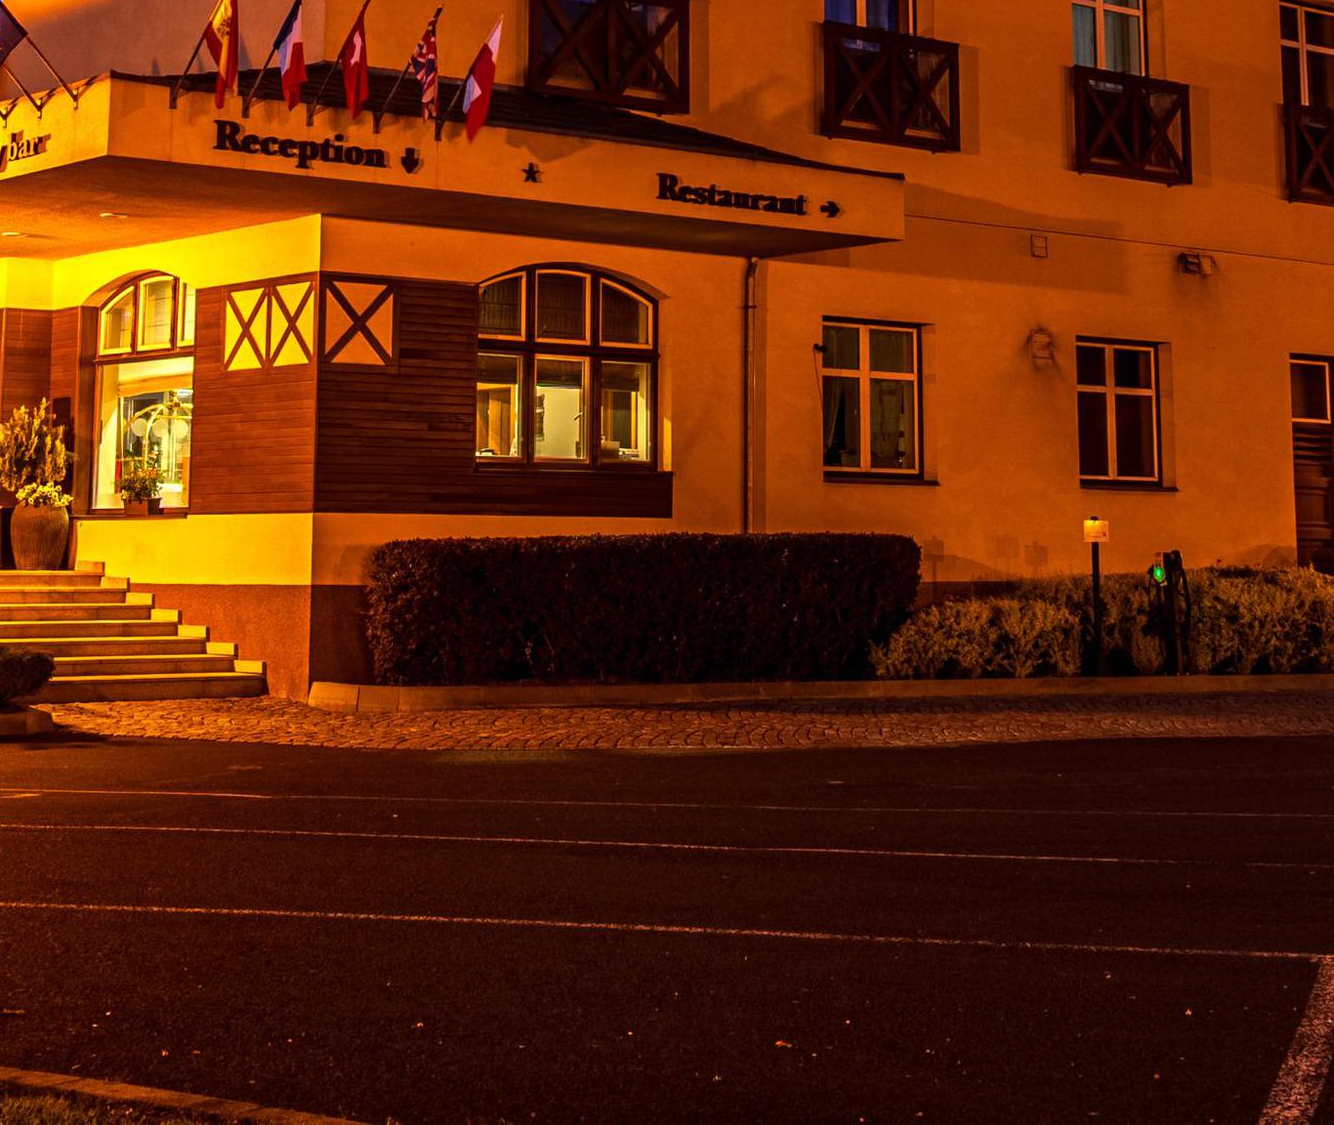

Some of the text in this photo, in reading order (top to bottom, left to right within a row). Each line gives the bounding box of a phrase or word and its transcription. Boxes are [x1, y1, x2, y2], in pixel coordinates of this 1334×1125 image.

[9, 131, 47, 161] bar
[213, 119, 389, 169] Reception
[656, 172, 807, 216] Restaurant
